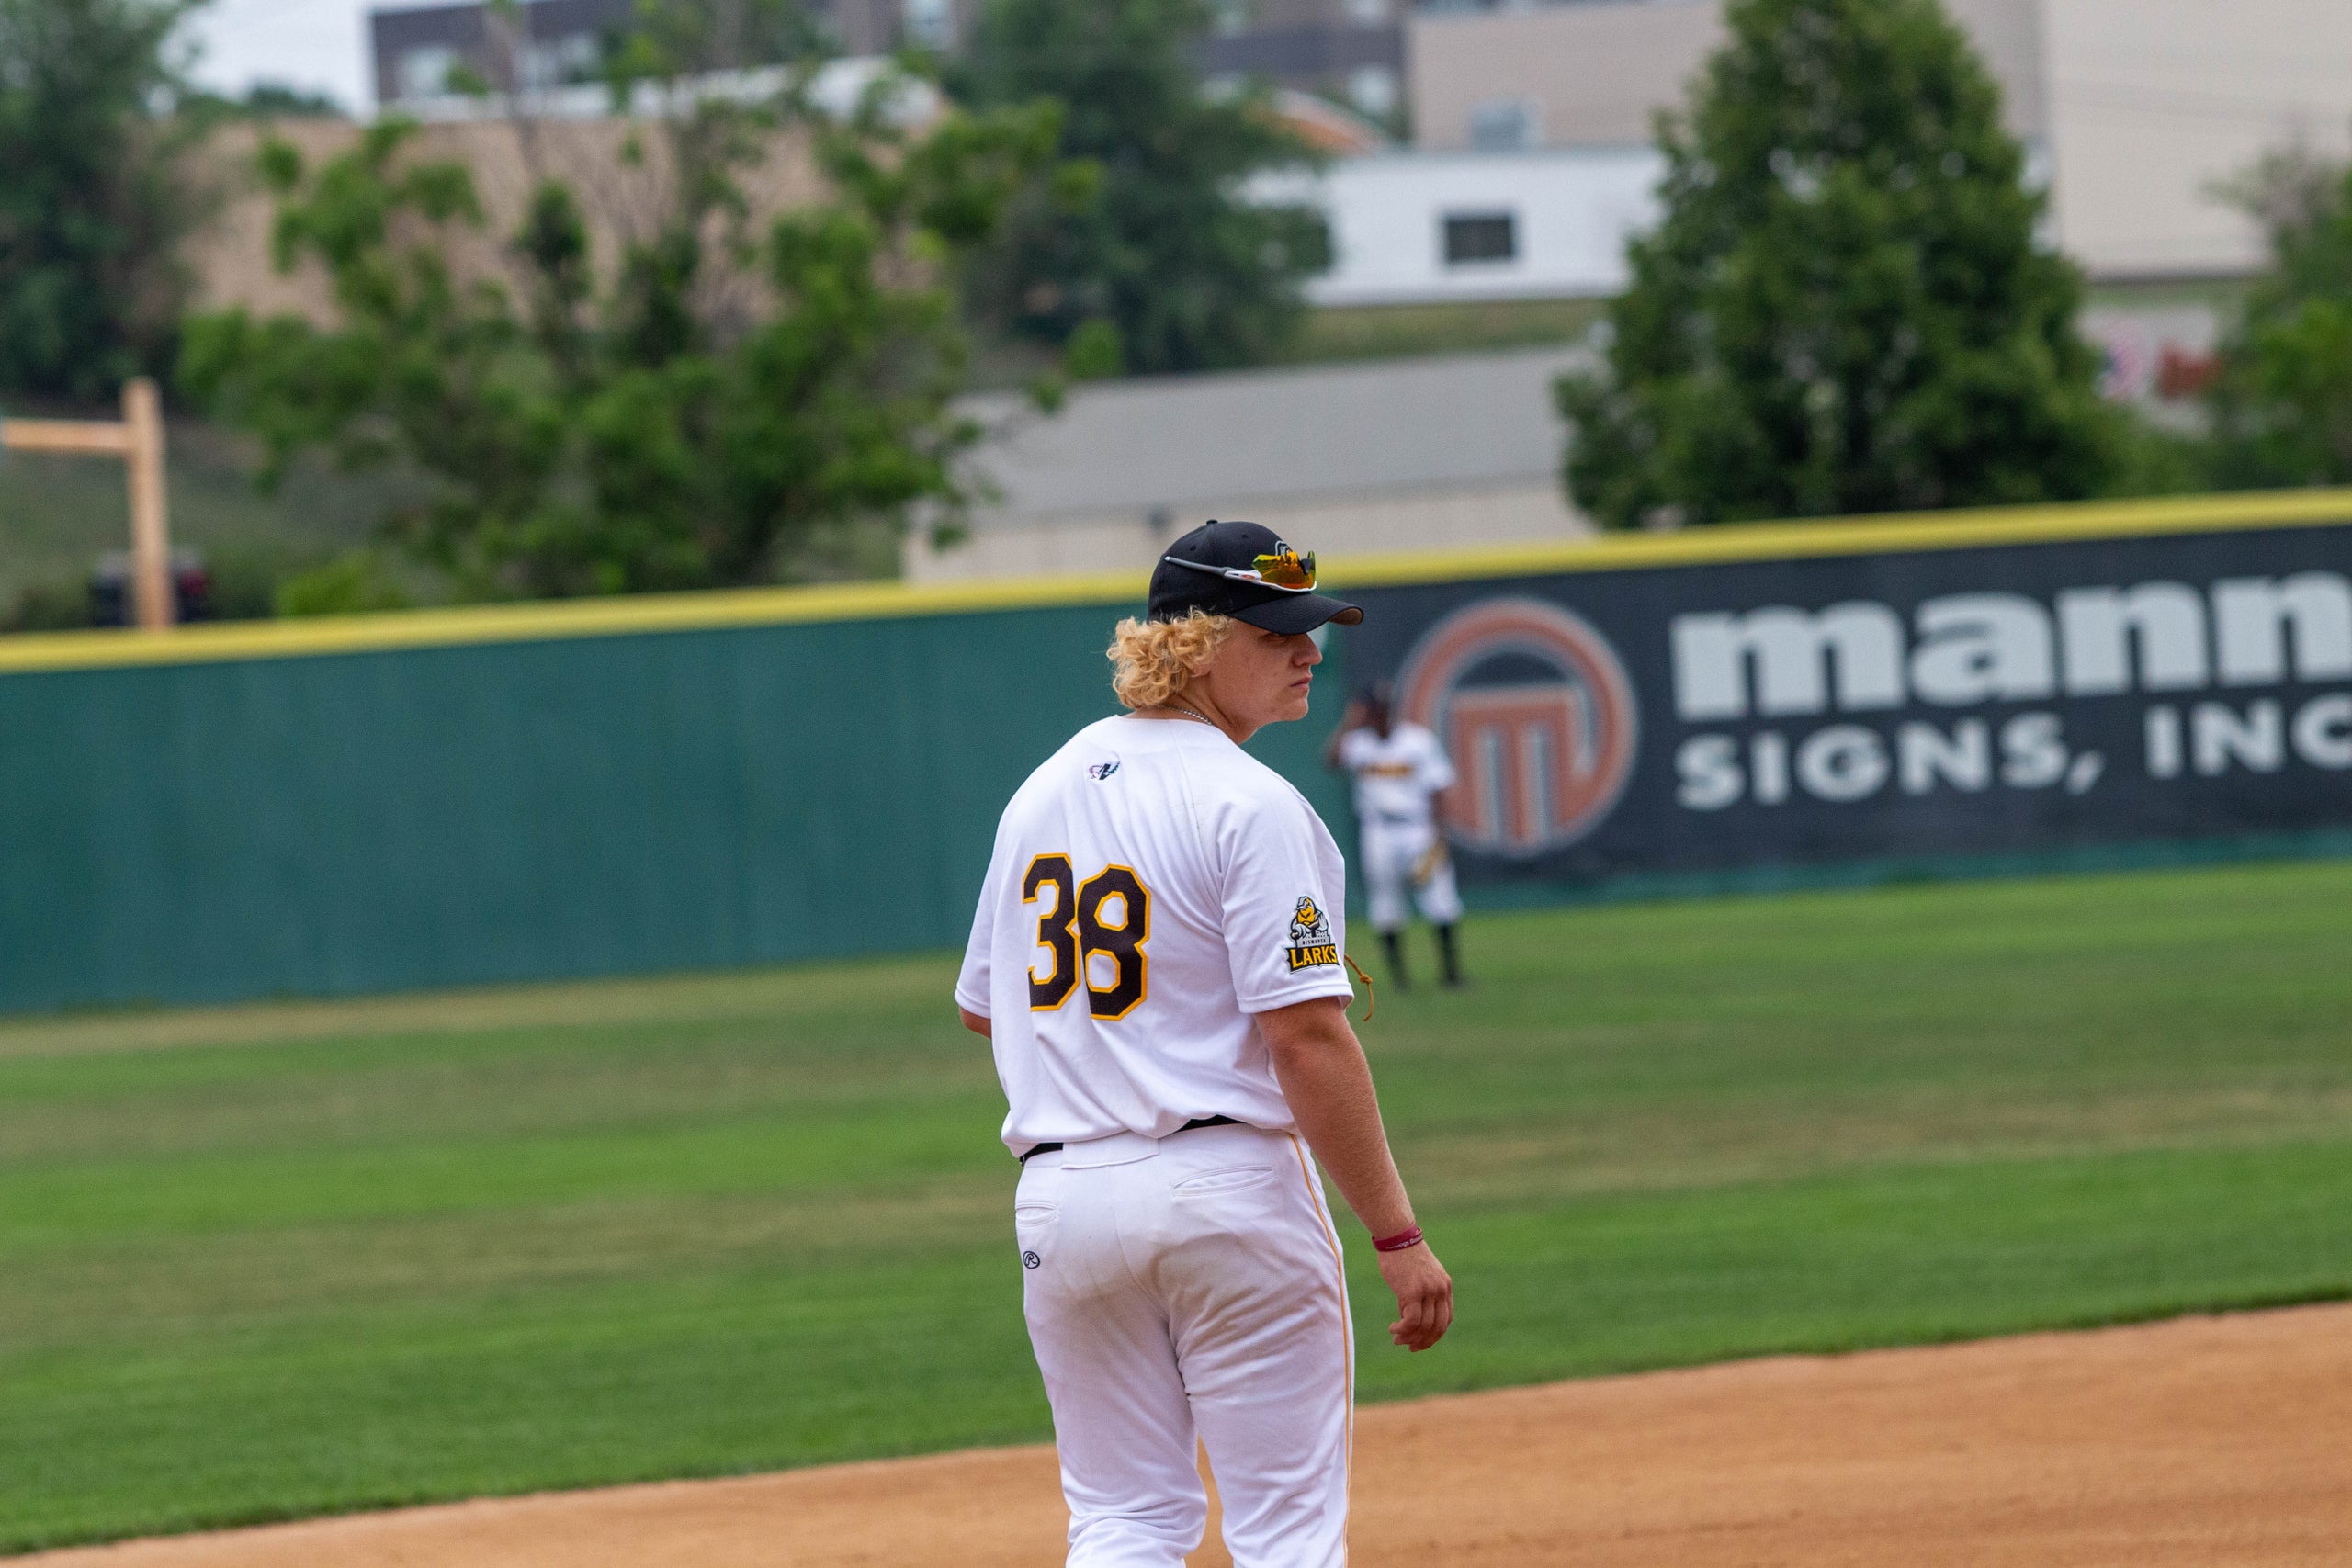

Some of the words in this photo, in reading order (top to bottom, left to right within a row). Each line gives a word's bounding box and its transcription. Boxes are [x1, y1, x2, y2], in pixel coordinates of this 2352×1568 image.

[1670, 570, 2352, 722] mann
[1676, 711, 2105, 811] SIGNS,
[2144, 693, 2352, 780] INC
[1022, 852, 1151, 1021] 38
[1290, 945, 1338, 968] LARKS
